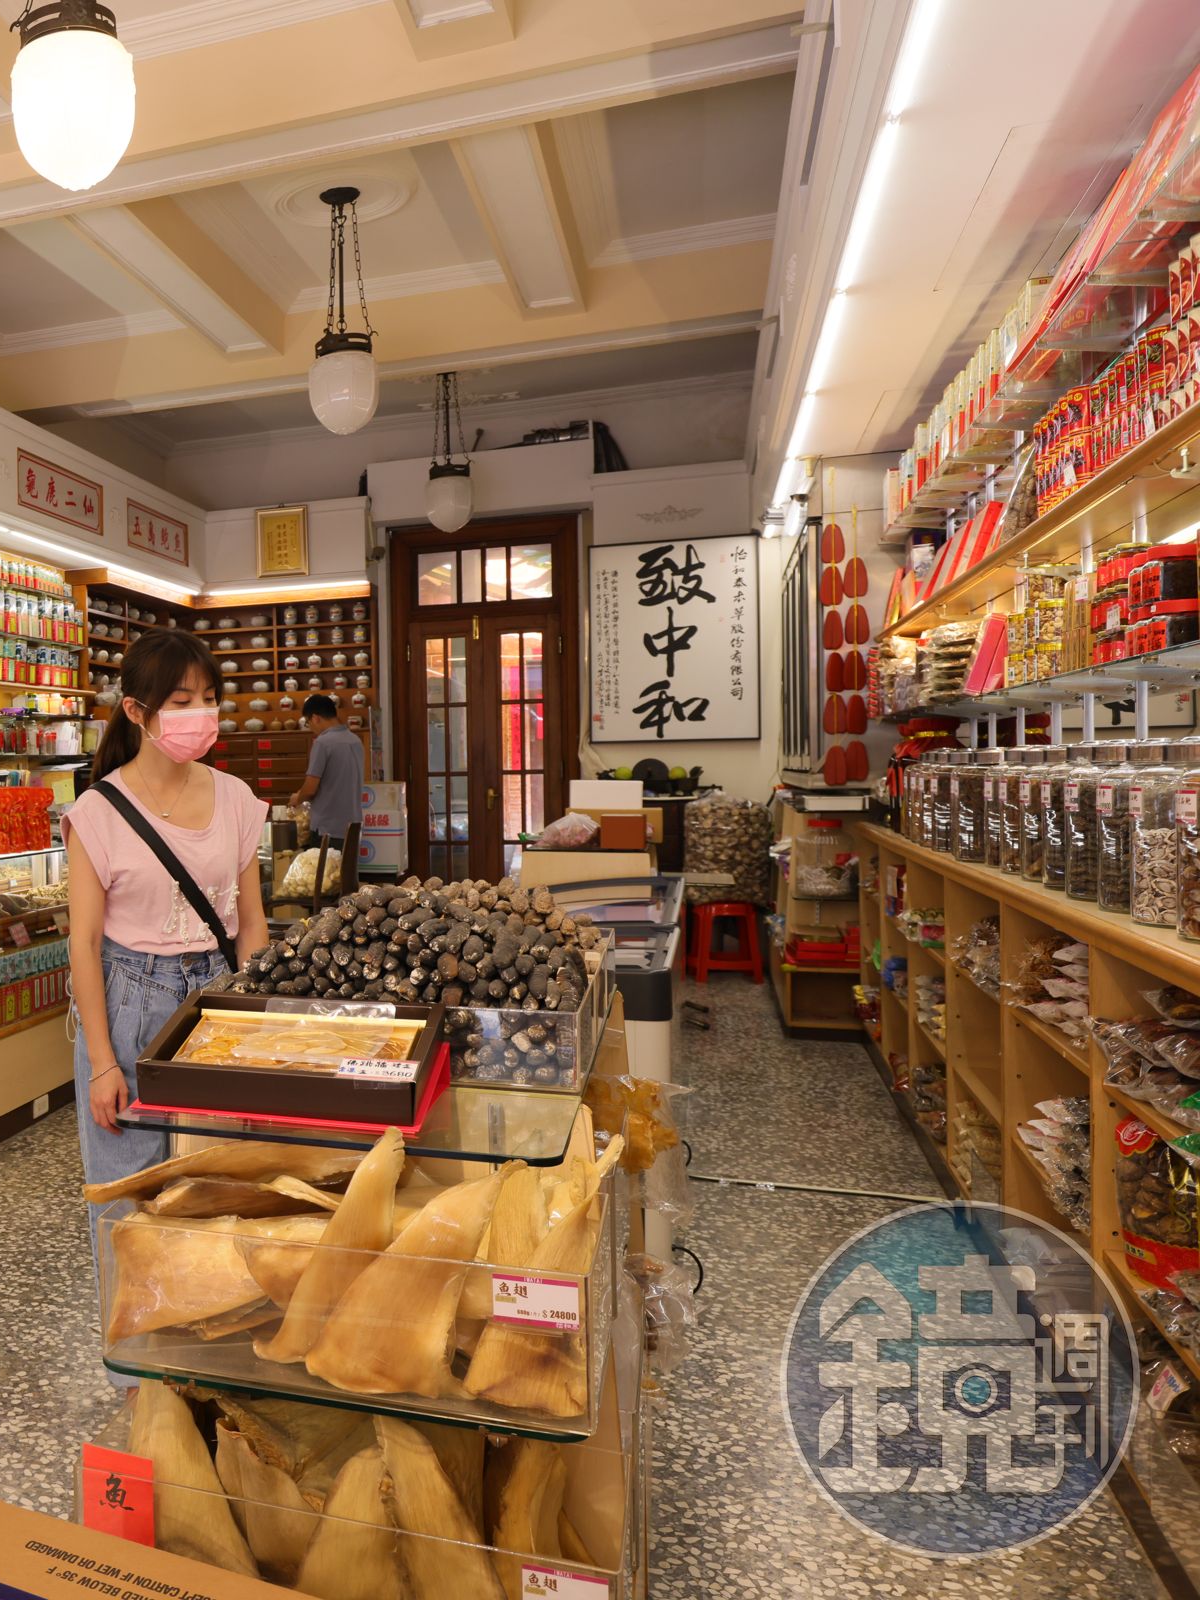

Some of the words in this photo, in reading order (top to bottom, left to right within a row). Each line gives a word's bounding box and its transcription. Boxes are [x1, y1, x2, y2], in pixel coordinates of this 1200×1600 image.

[25, 467, 95, 516] 龜鹿二仙
[632, 544, 716, 738] 致中和
[497, 1281, 528, 1299] 魚翅
[550, 1309, 577, 1321] 24800
[99, 1474, 135, 1512] 魚
[25, 1540, 80, 1564] DAMAGED
[77, 1557, 96, 1570] OR
[94, 1563, 121, 1578] WET
[77, 1576, 121, 1597] BELOW
[120, 1572, 134, 1582] IF
[132, 1575, 180, 1597] CARTON
[528, 1573, 559, 1592] 魚翅
